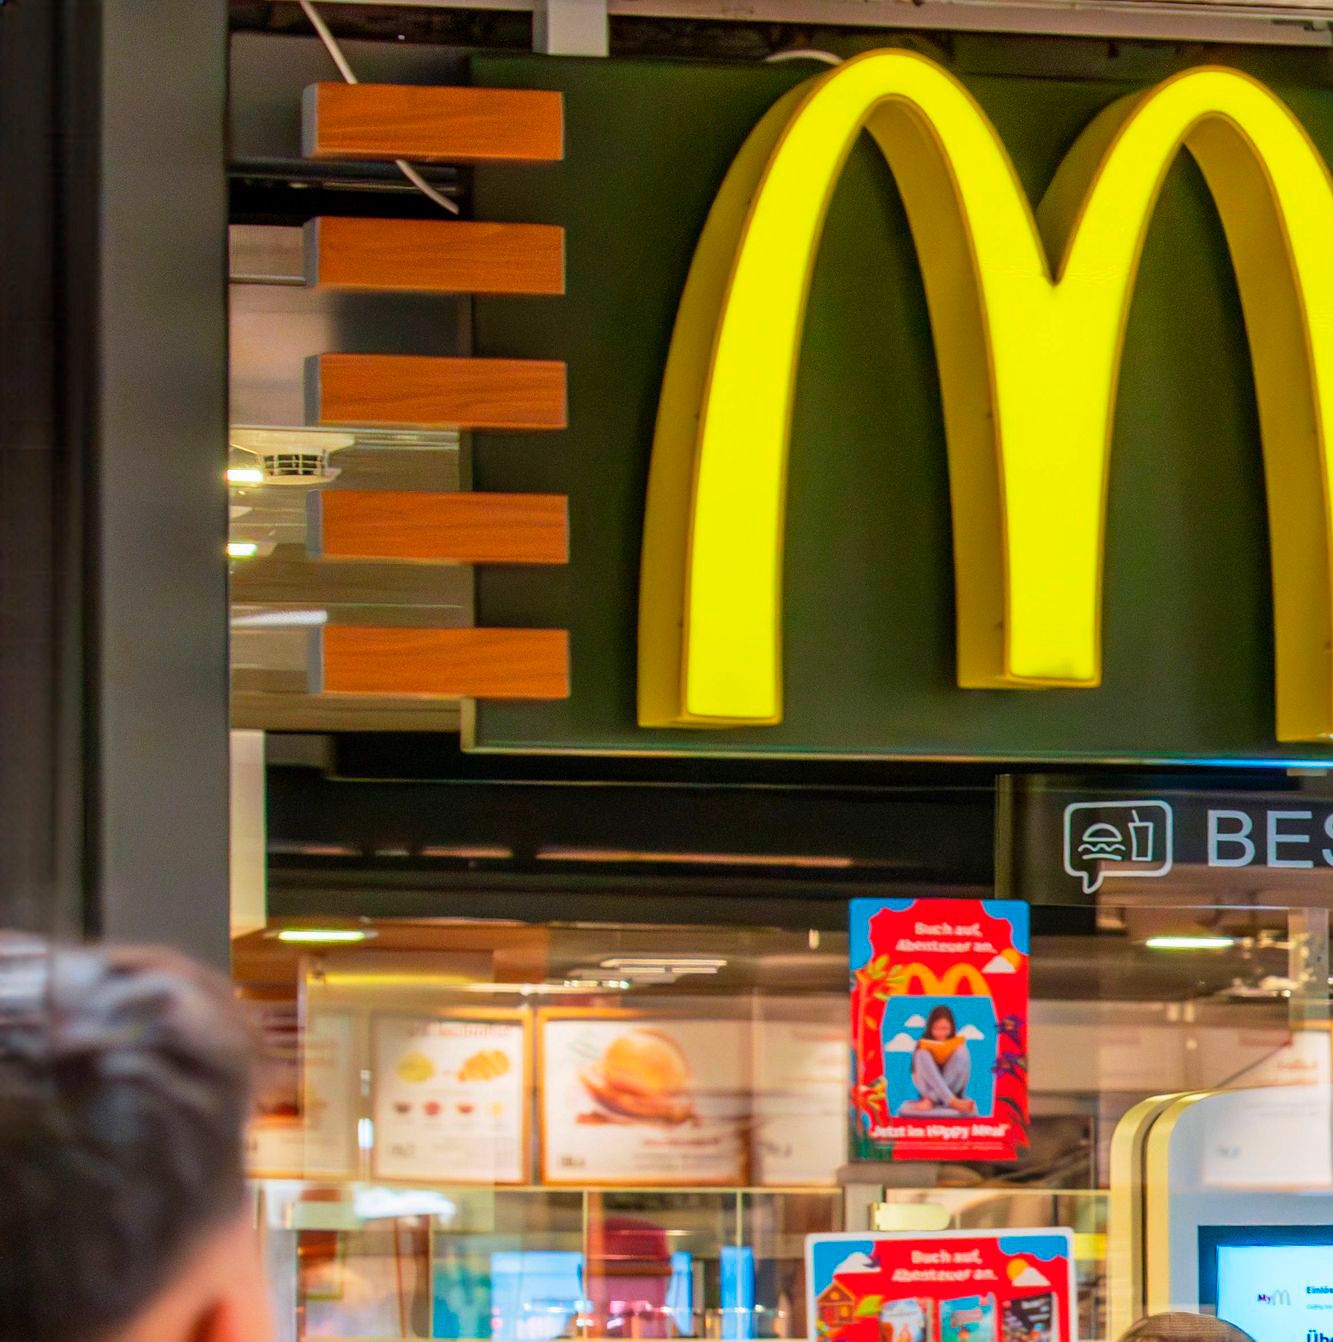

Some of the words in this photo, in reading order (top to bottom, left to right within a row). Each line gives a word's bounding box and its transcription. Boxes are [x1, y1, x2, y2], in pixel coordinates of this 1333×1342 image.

[914, 922, 952, 936] Buch
[896, 939, 971, 952] Abenteuer
[873, 1124, 905, 1137] Jetzt
[926, 1124, 970, 1139] Happy
[910, 1250, 951, 1265] Buch
[891, 1269, 971, 1283] Abenteuer
